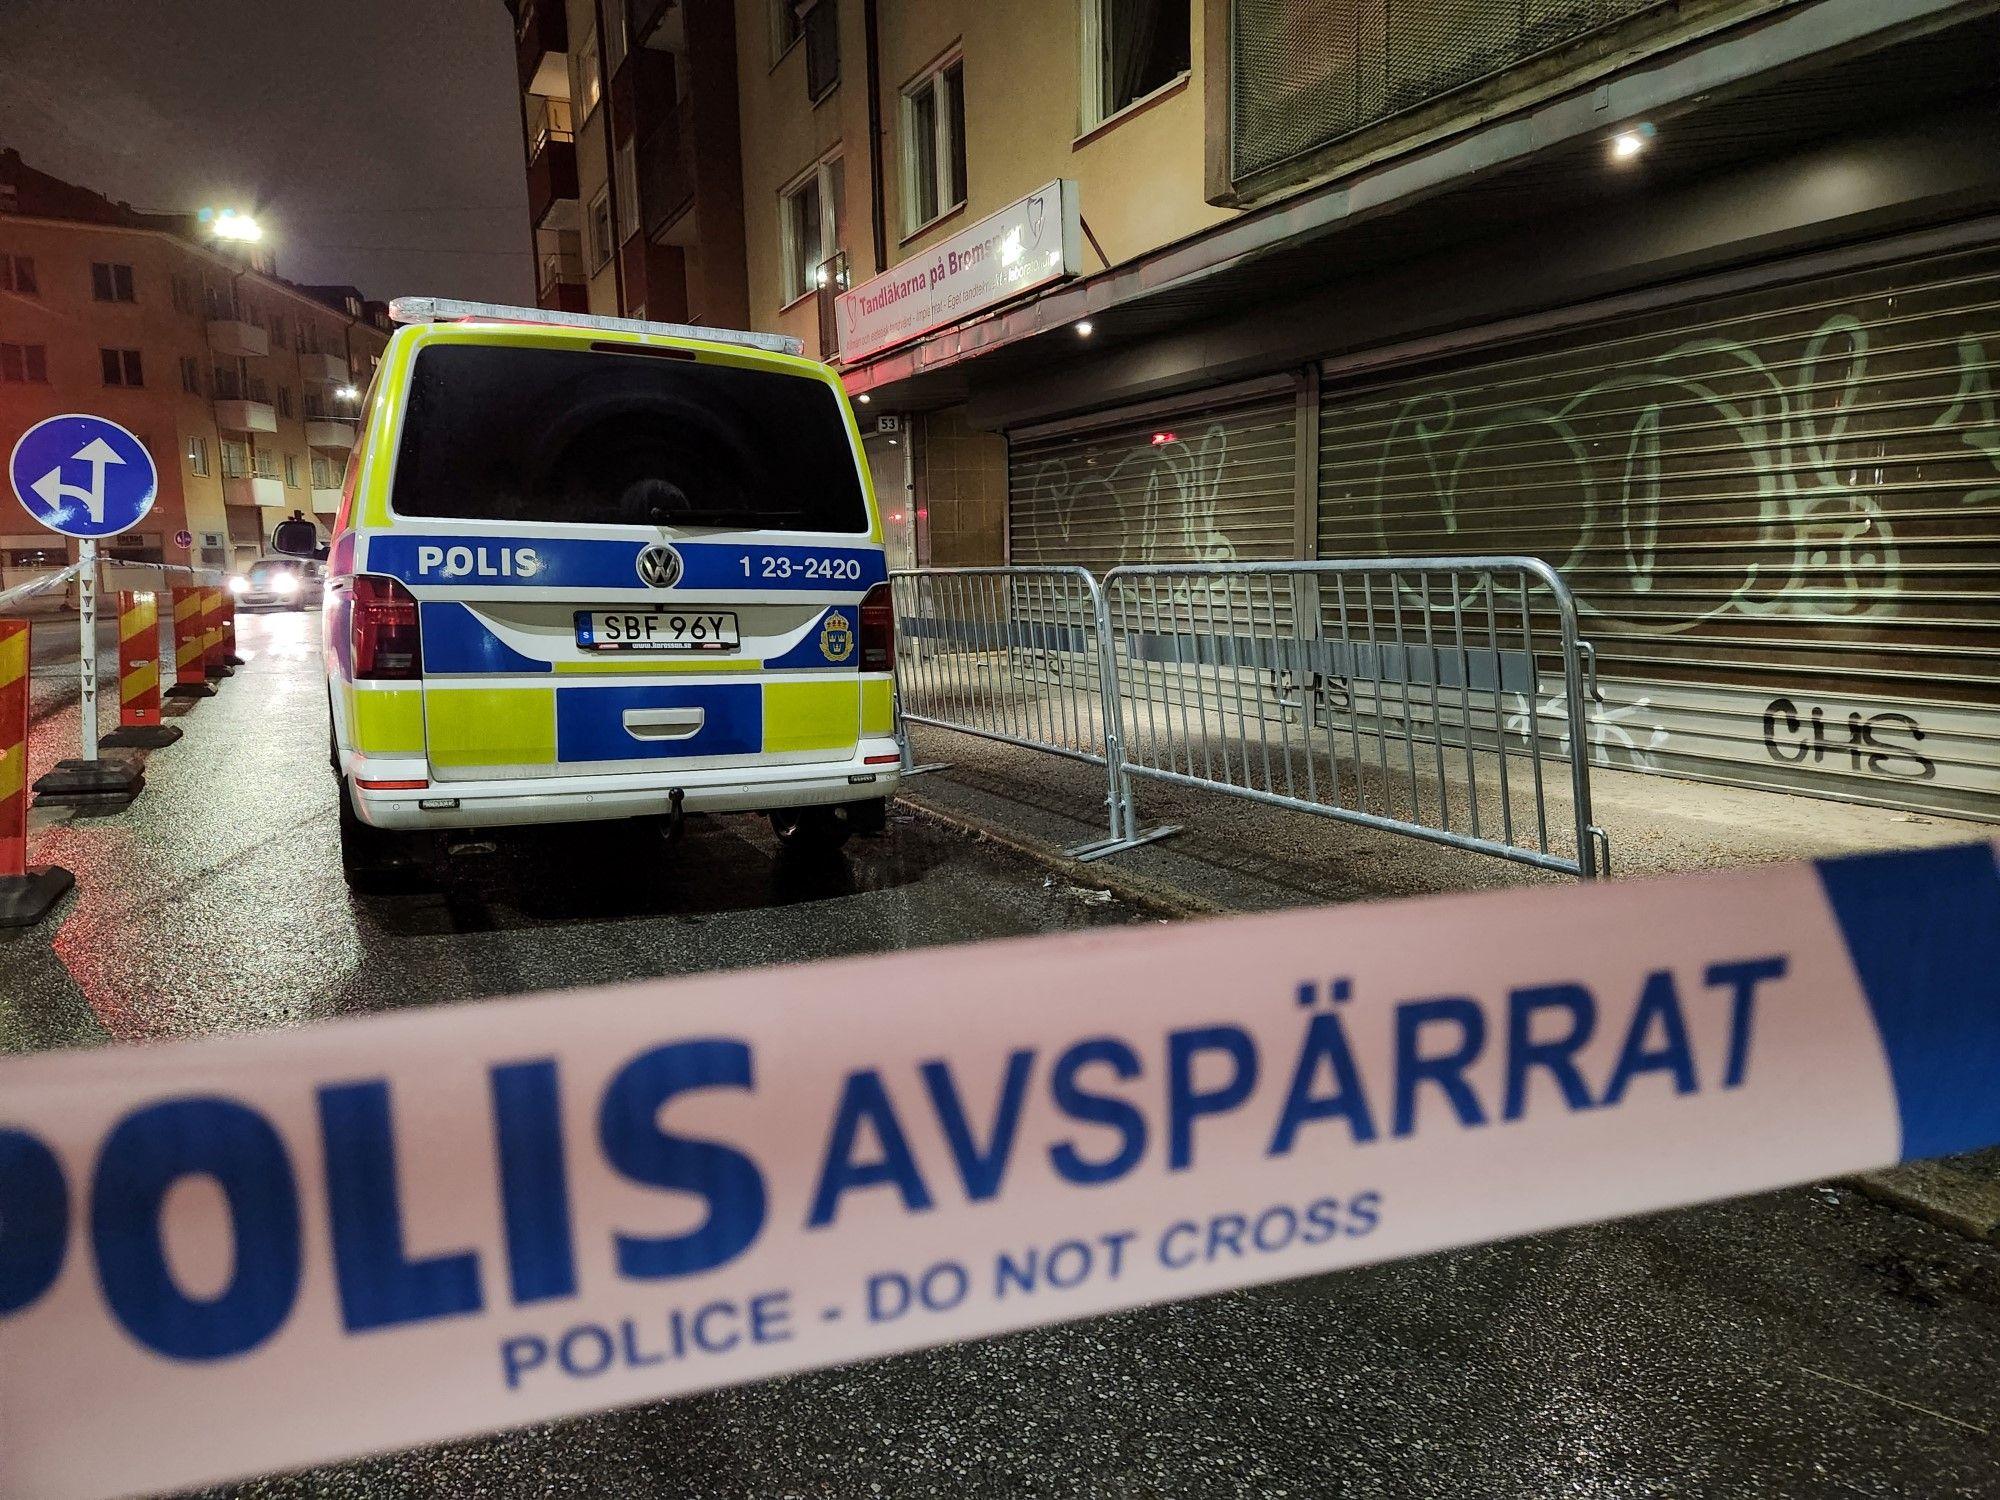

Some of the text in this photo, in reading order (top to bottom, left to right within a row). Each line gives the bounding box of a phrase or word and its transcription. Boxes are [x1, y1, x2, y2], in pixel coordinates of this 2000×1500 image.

[860, 272, 926, 317] Tandläkarna
[930, 256, 945, 290] på
[881, 418, 896, 430] 53
[418, 546, 538, 577] POLIS
[739, 557, 861, 581] 1 23-2420
[604, 615, 724, 640] SBF 96Y
[1763, 698, 1937, 781] CHS
[803, 954, 1789, 1230] AVSPÄRRAT
[500, 1288, 794, 1391] POLICE
[865, 1260, 970, 1326] DO
[993, 1230, 1137, 1299] NOT
[1158, 1191, 1383, 1273] CROSS
